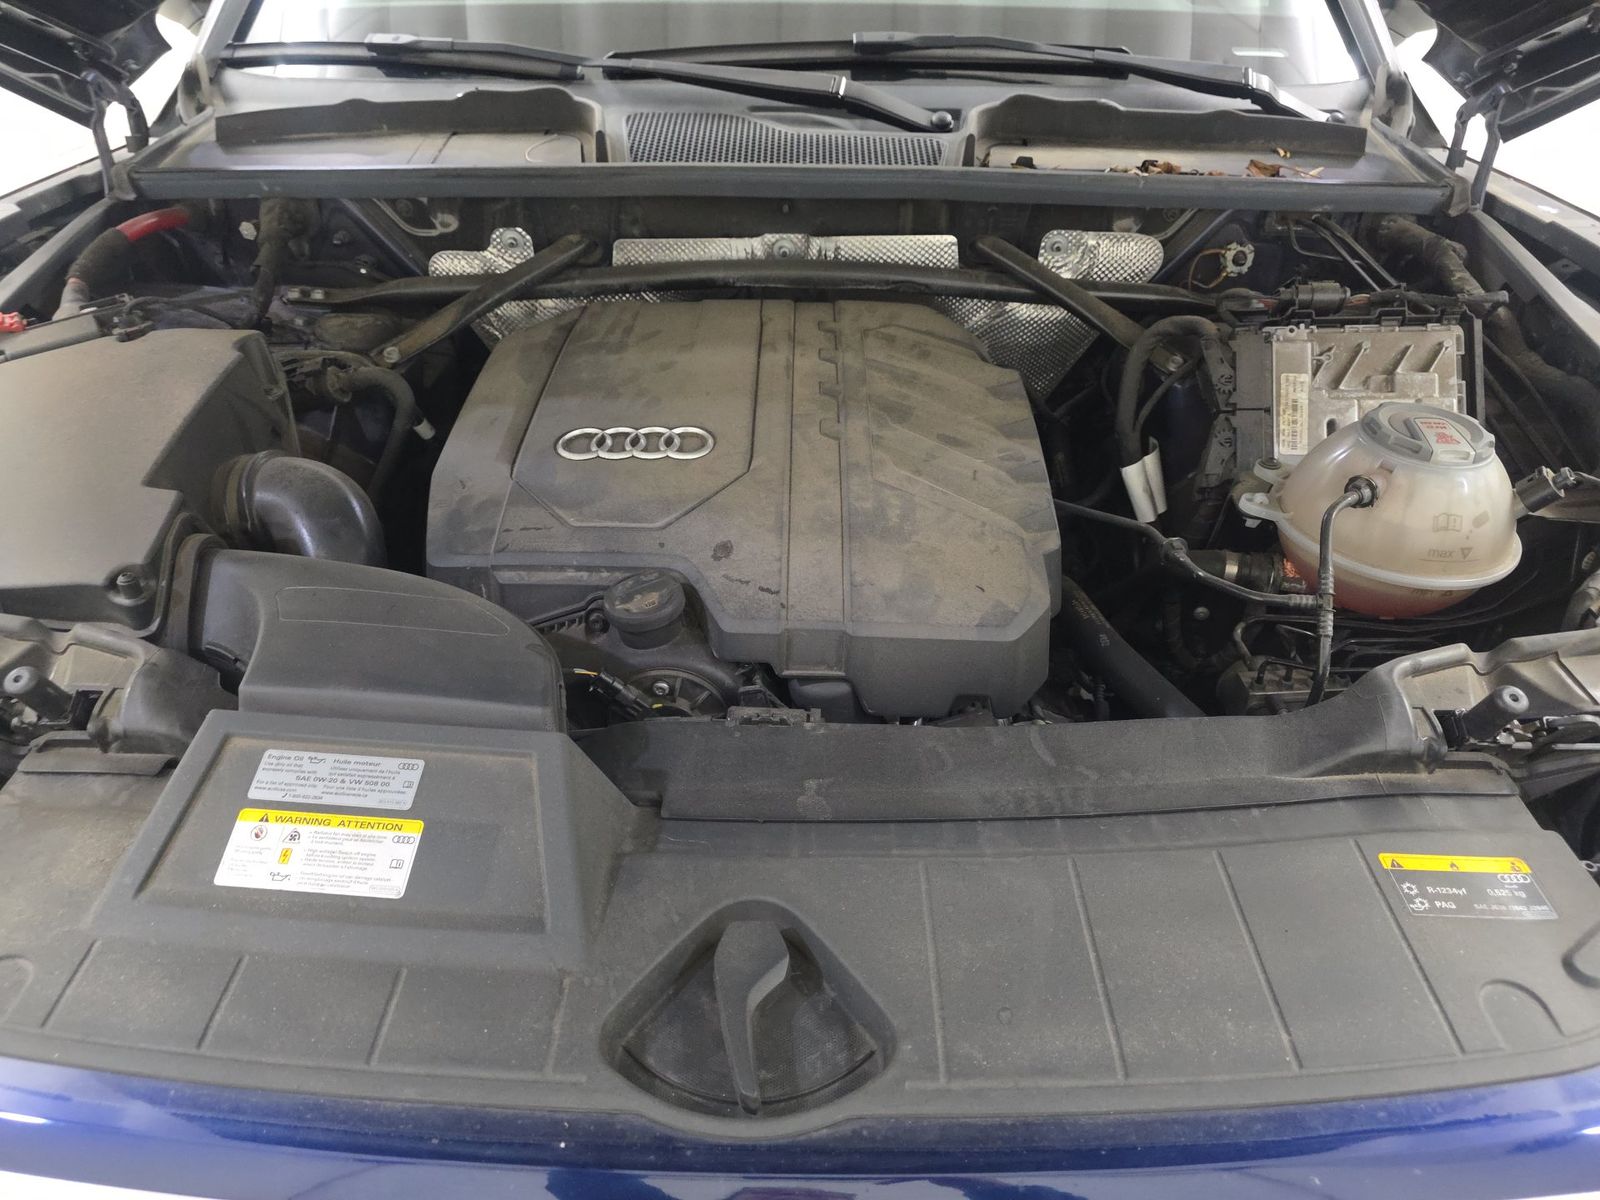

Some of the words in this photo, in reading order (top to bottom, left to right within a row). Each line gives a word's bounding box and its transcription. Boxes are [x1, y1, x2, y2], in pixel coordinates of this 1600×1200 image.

[1427, 549, 1456, 559] max
[267, 753, 292, 761] Engine
[275, 815, 332, 827] WARNING
[337, 819, 404, 832] ATTENTION
